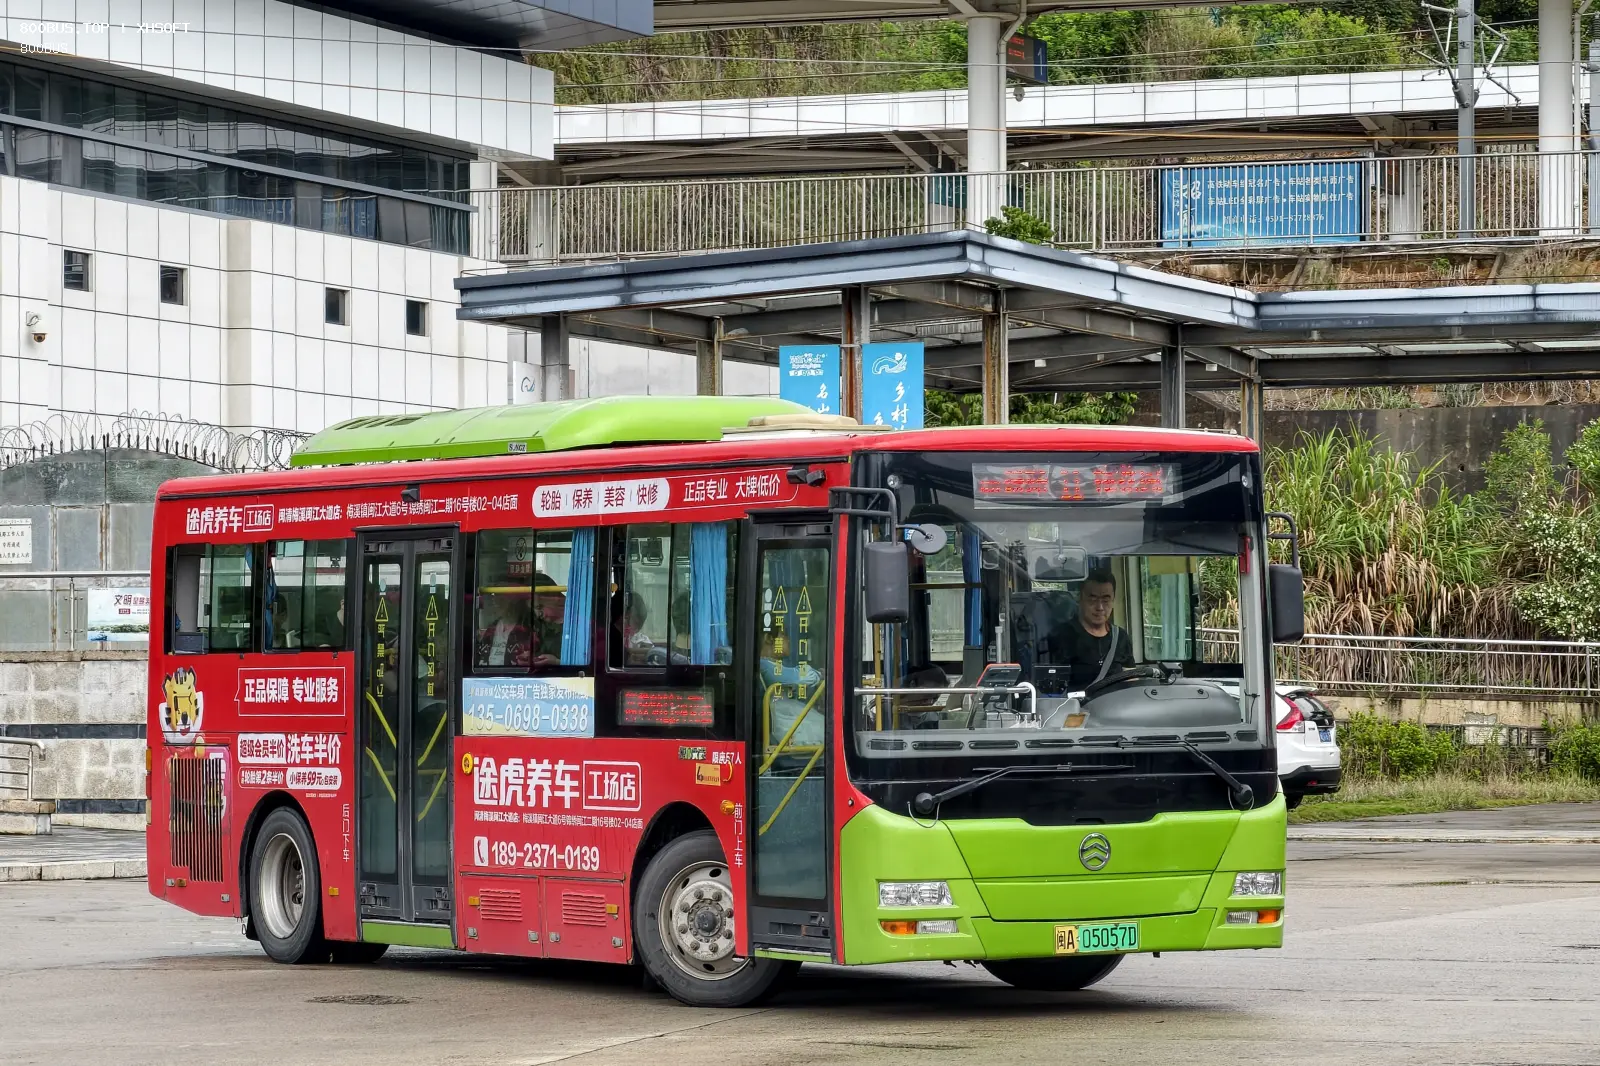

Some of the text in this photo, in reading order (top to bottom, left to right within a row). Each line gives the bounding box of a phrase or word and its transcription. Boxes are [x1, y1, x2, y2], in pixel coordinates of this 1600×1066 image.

[891, 380, 910, 431] 乡村
[541, 474, 780, 511] 轮胎 保养 美容 快修 正品专业 大牌低价
[186, 505, 243, 535] 途虎养车
[246, 510, 271, 527] 工场店
[244, 676, 339, 704] 正品保障 专业服务
[468, 703, 588, 731] 135-0698-0338
[240, 733, 341, 764] 超级会员半价 洗车半价
[473, 756, 636, 809] 途虎养车 工场店
[342, 803, 350, 862] 后门下车
[734, 803, 743, 868] 前门上车
[491, 841, 600, 871] 189-2371-0139
